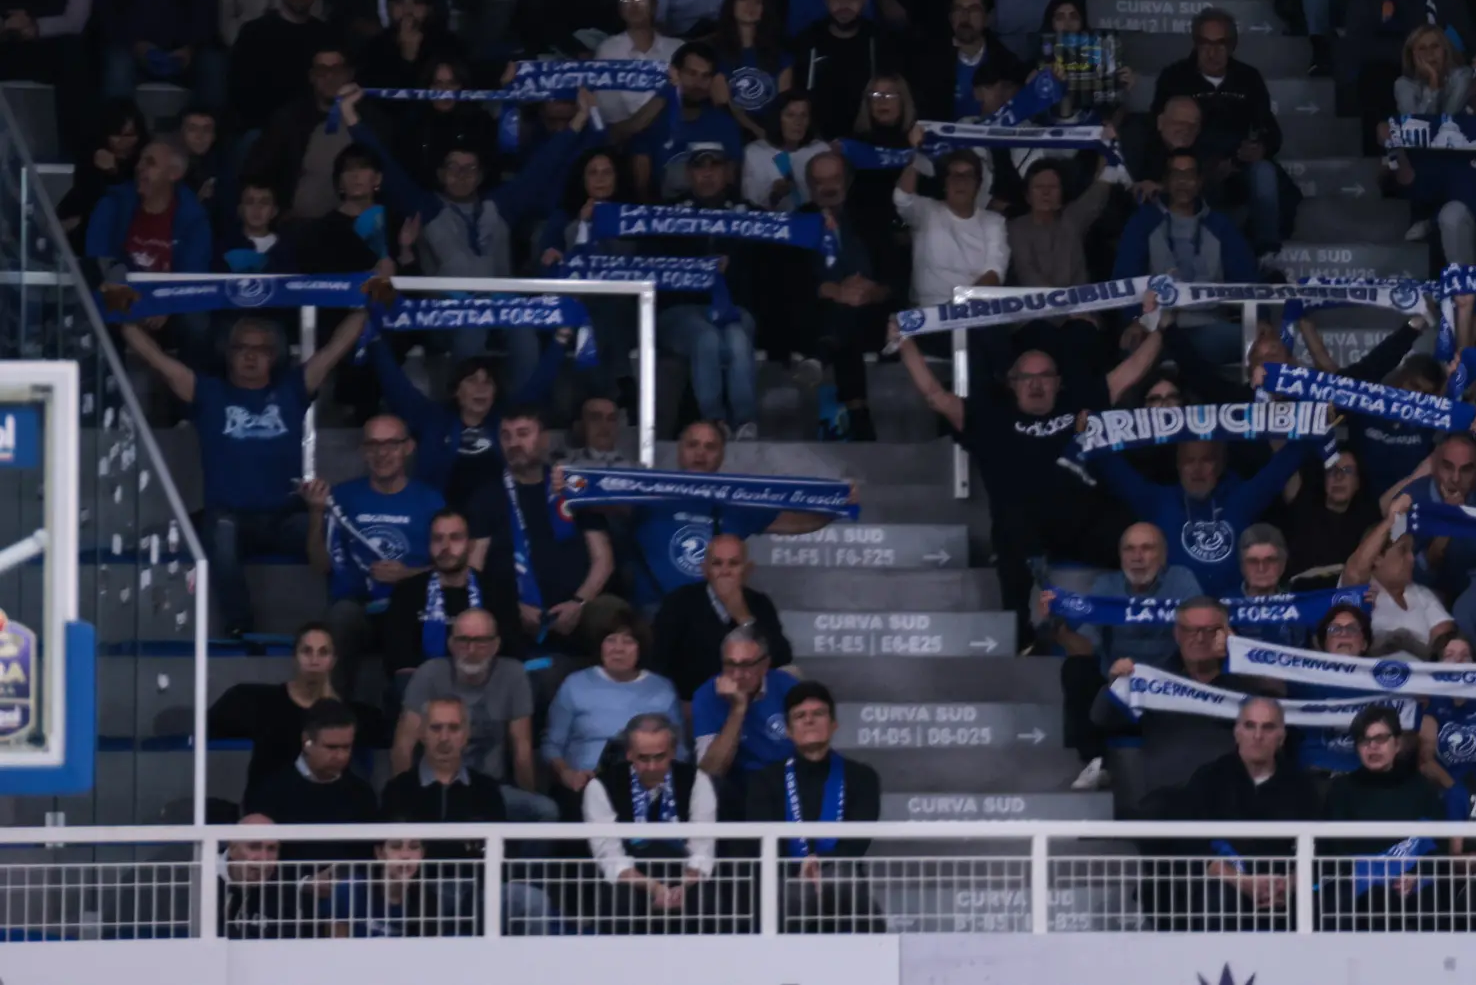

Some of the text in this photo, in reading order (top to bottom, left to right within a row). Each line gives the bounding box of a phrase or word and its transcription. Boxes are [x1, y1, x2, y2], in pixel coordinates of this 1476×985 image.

[1116, 0, 1174, 14] CURVA
[619, 219, 648, 235] LA
[652, 218, 726, 236] NOSTRA
[1317, 249, 1353, 263] SUD
[938, 278, 1136, 321] IRRIDUCIBILI
[1275, 378, 1304, 395] LA
[1309, 382, 1386, 414] NOSTRA
[1083, 401, 1336, 452] RRIDUCIBIL
[843, 527, 885, 544] SUD
[770, 548, 819, 566] F1-F5
[813, 615, 931, 631] CURVA SUD
[1124, 606, 1153, 622] LA
[813, 635, 943, 653] E1-E5 E6-E25
[1276, 652, 1357, 674] GERMANI
[1149, 680, 1225, 704] GERMANI
[860, 706, 978, 723] CURVA SUD
[857, 727, 911, 746] D1-D5
[907, 797, 1026, 814] CURVA SUD
